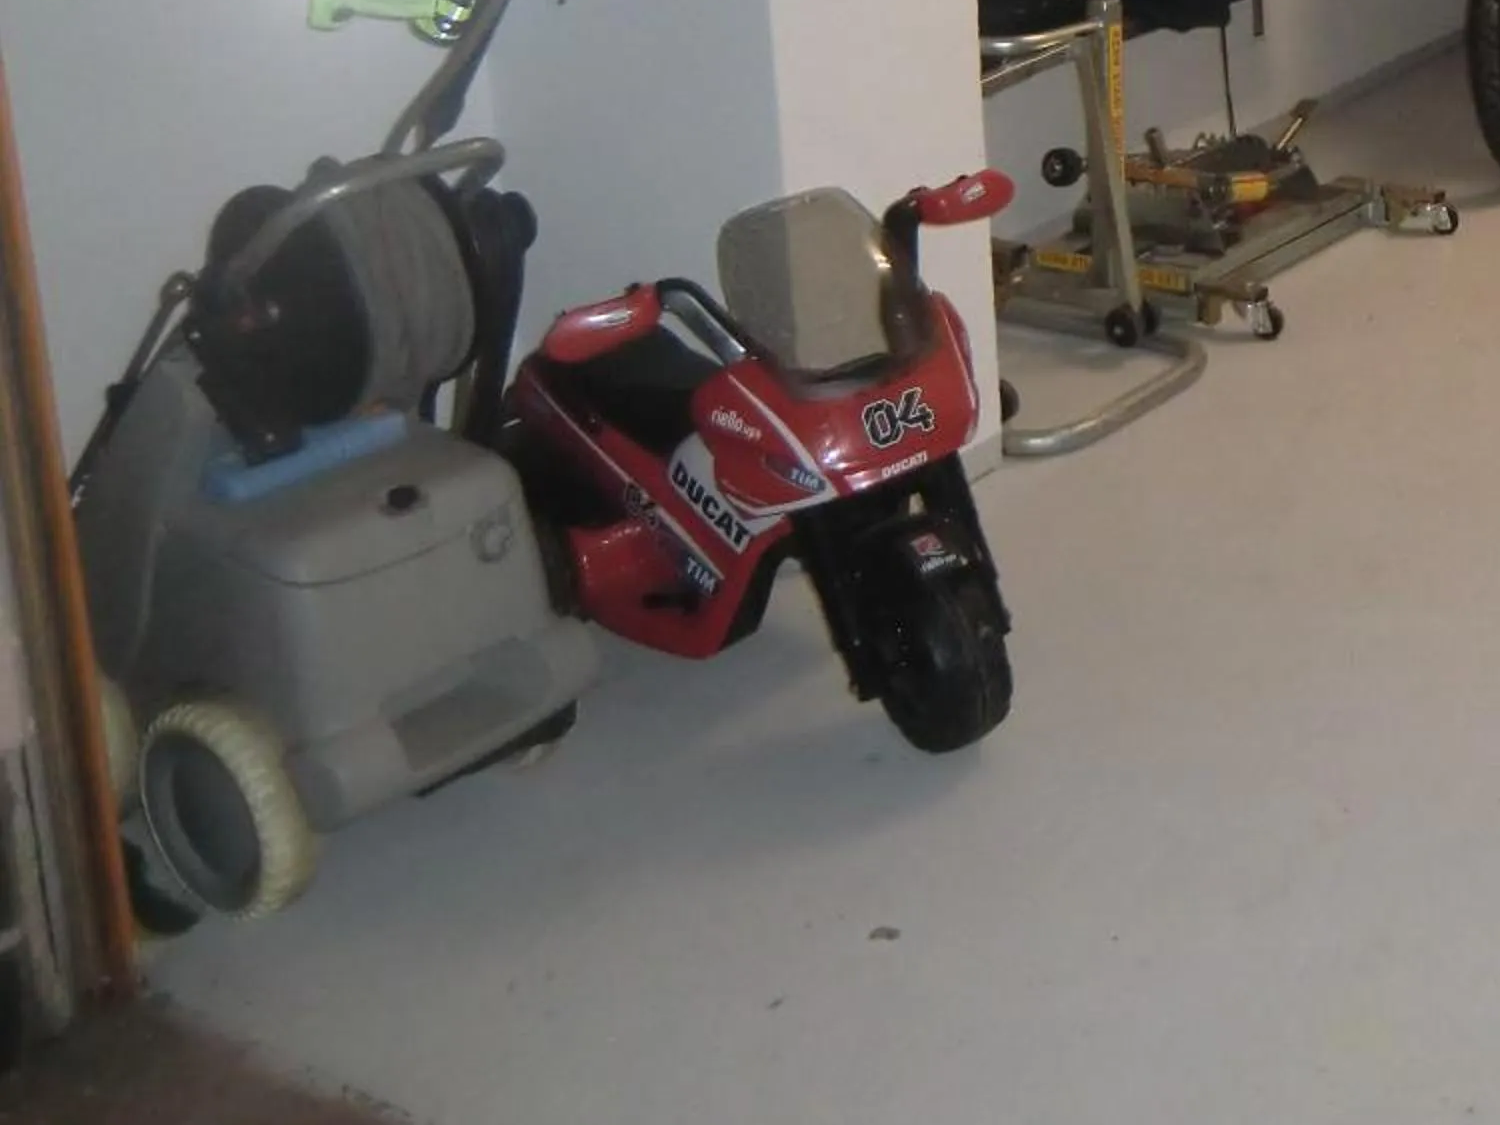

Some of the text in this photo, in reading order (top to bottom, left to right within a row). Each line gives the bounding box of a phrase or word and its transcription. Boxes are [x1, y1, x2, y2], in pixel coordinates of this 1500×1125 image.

[861, 386, 935, 449] 04
[790, 468, 820, 490] TIM
[881, 451, 929, 480] DUCATI
[686, 556, 717, 596] TIM
